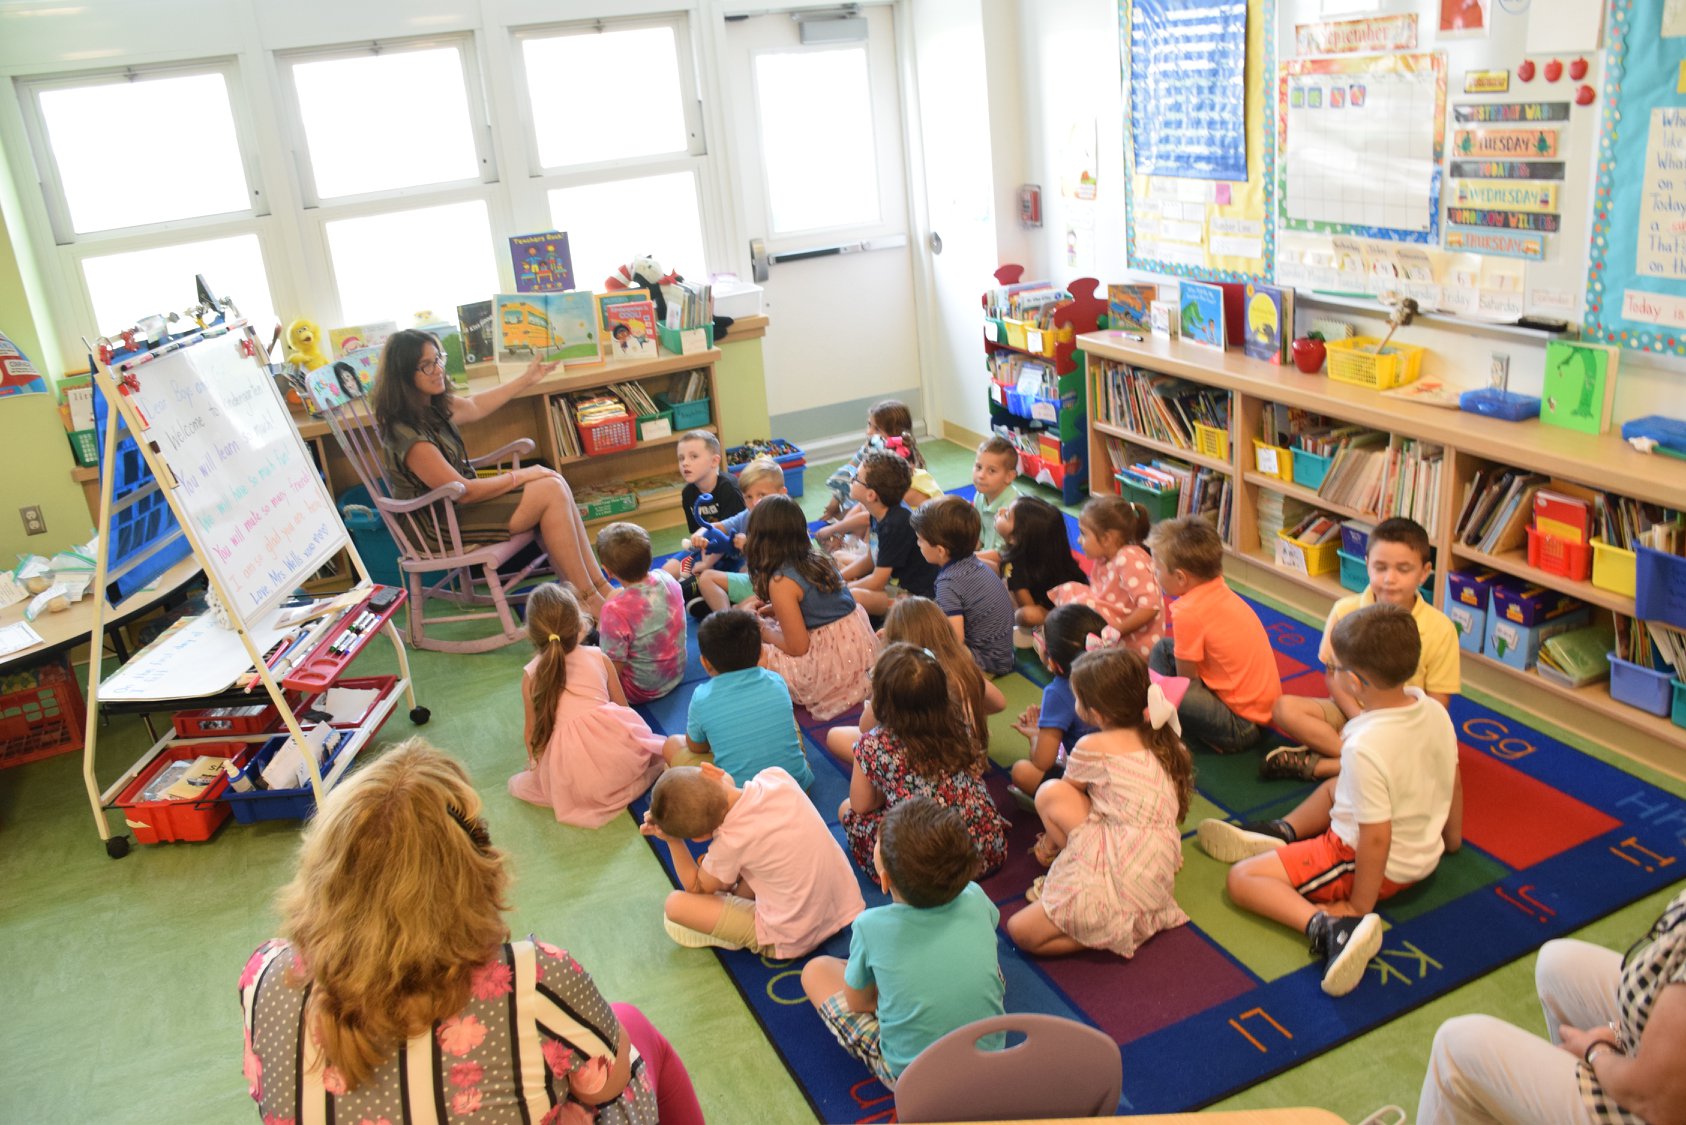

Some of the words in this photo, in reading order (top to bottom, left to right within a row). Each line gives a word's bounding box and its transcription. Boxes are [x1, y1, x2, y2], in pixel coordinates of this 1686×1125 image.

[1479, 135, 1530, 152] TUESDAY
[1469, 185, 1539, 205] WEDNESDAY
[1466, 232, 1523, 253] THURSDAY
[1626, 294, 1661, 322] Today
[166, 417, 205, 450] Welcome
[198, 450, 218, 478] will
[214, 441, 240, 463] learn
[1462, 718, 1537, 760] Gg
